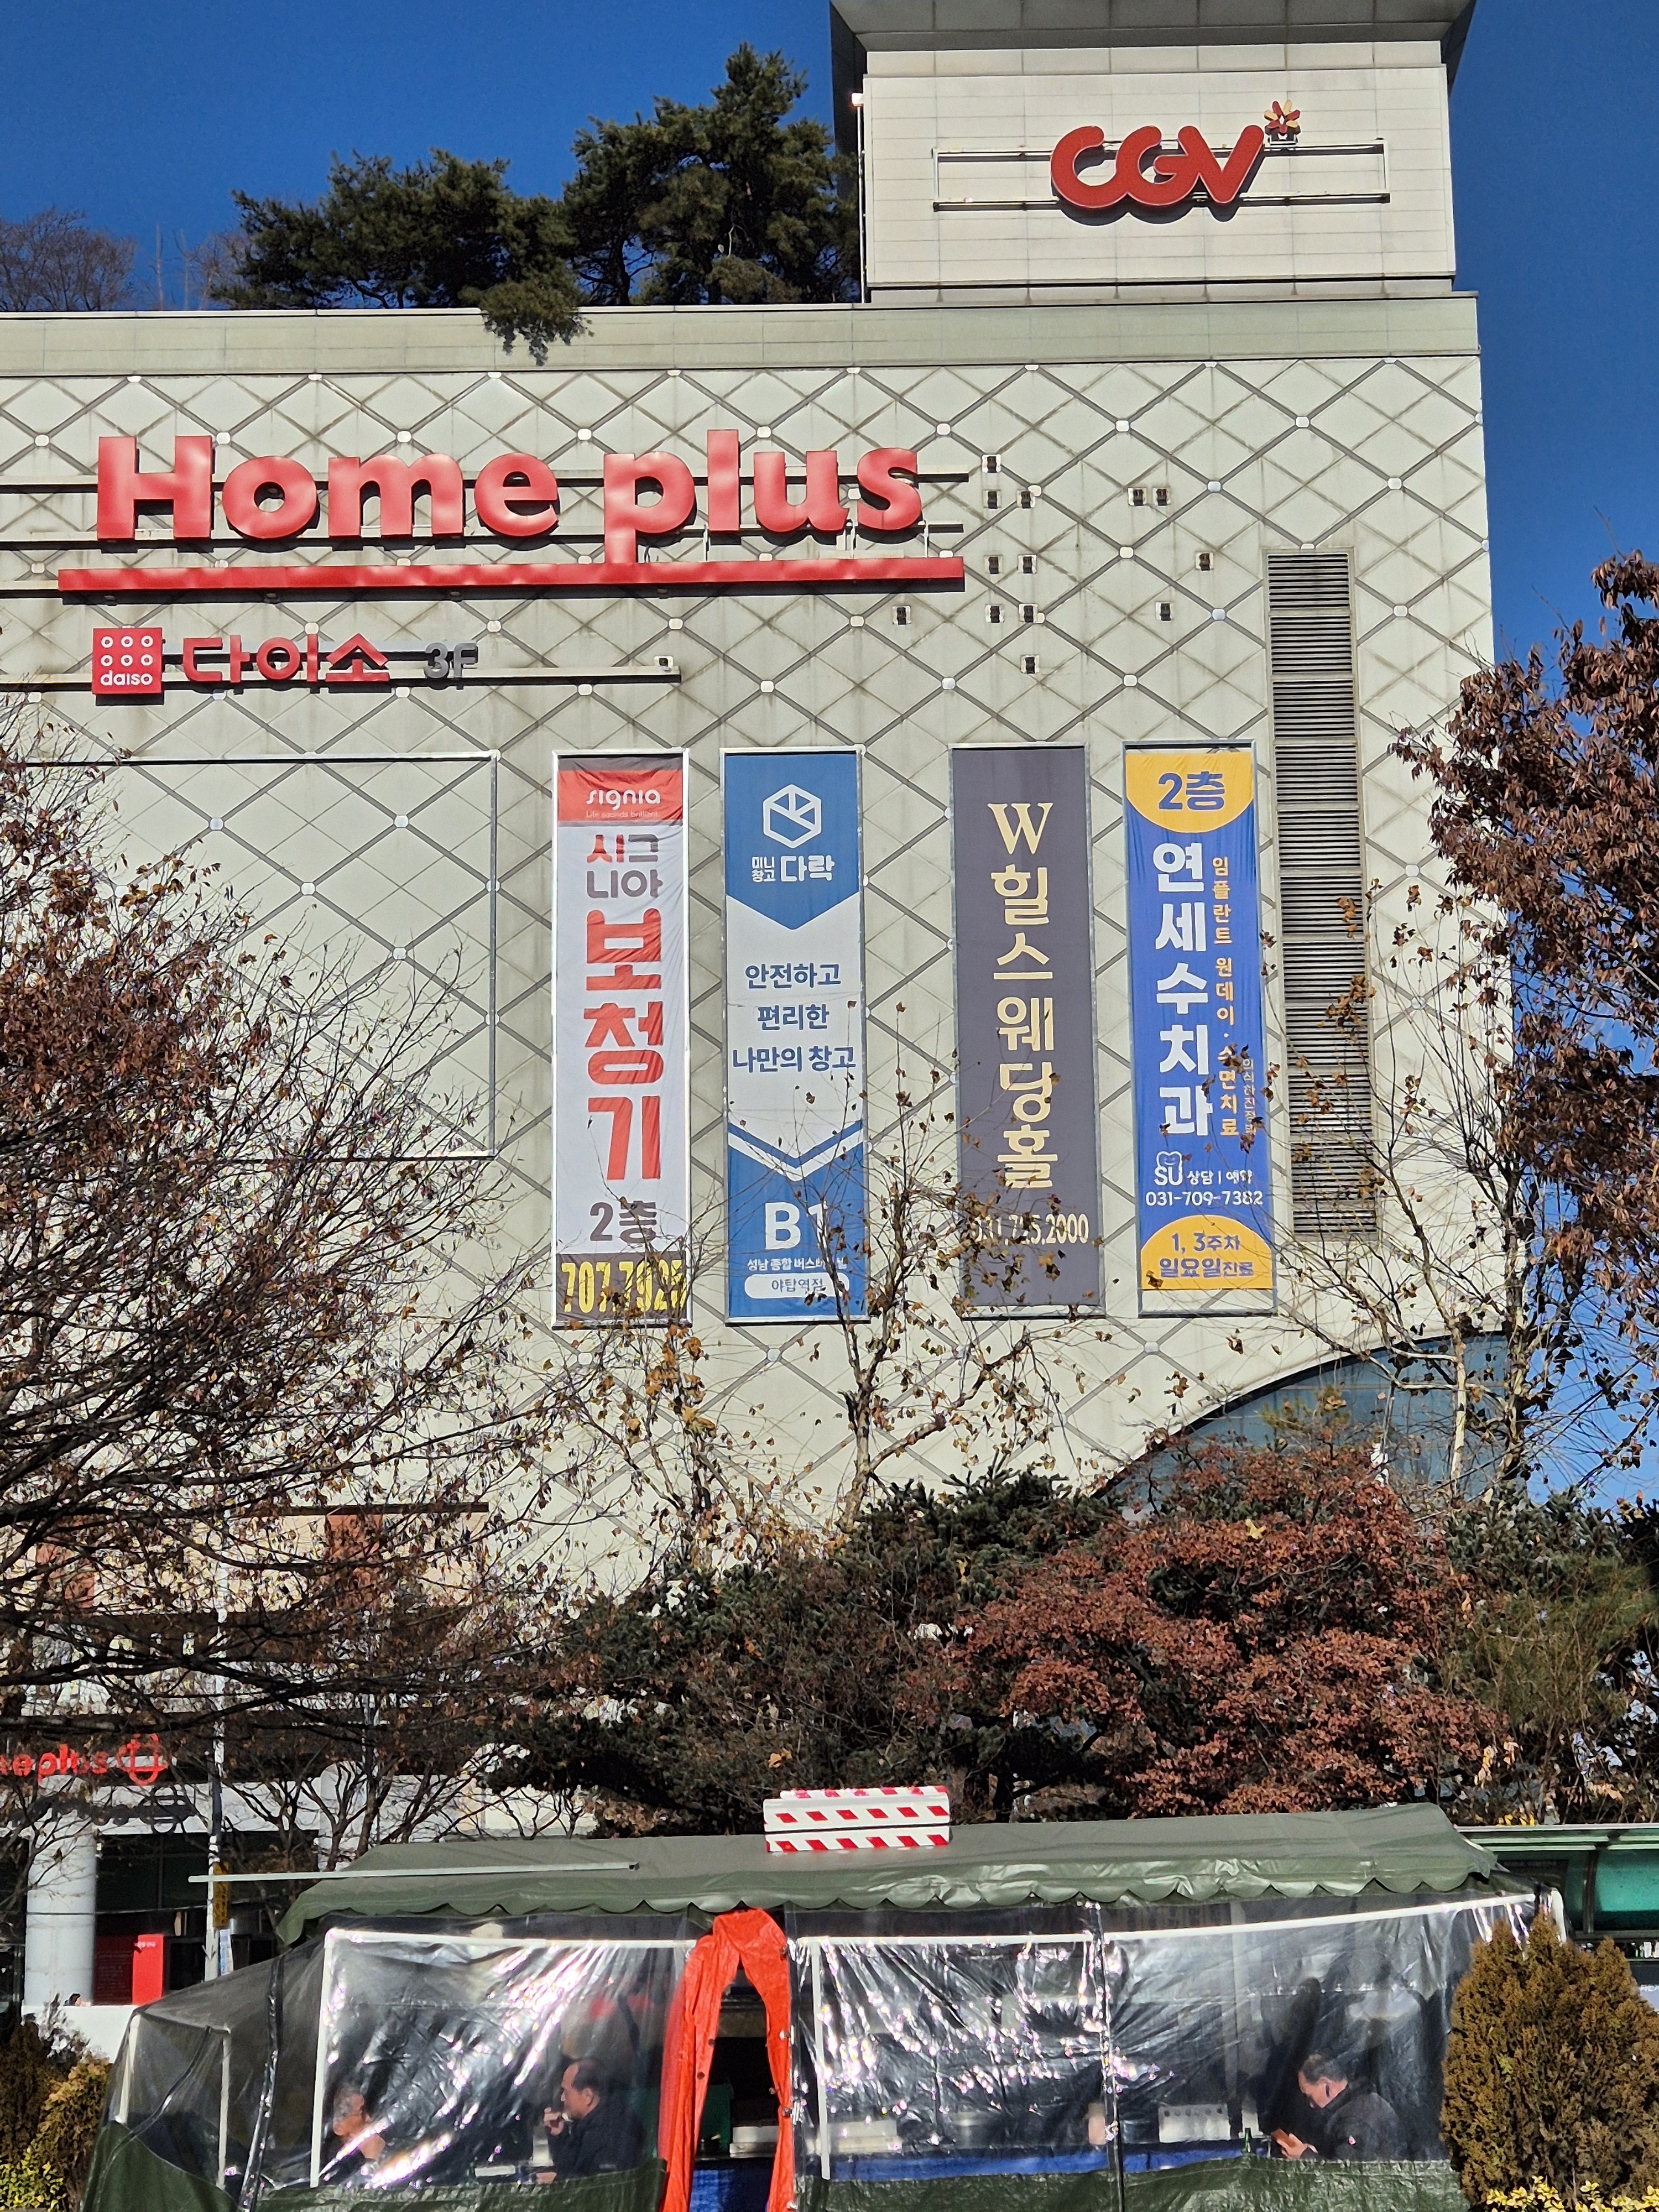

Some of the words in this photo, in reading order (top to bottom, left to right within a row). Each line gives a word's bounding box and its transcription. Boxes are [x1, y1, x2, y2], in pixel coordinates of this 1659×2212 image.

[1051, 125, 1264, 208] CGV
[97, 435, 559, 541] Home
[604, 429, 924, 564] plus
[182, 633, 390, 684] 다이소
[423, 642, 478, 679] 3F
[100, 671, 153, 687] daiso
[586, 789, 660, 811] signia
[1158, 771, 1225, 811] 2층
[587, 834, 659, 863] 시그
[752, 856, 775, 869] 미니
[780, 854, 835, 882] 다락
[587, 869, 663, 899] 니아
[1212, 856, 1233, 945] 임플란트
[744, 963, 842, 989] 안전하고
[1152, 842, 1213, 1136] 연세수치과
[757, 1004, 830, 1031] 편리한
[583, 907, 664, 1181] 보청기
[732, 1047, 802, 1073] 나만의
[808, 1046, 857, 1072] 창고
[1154, 1166, 1183, 1186] SU
[1187, 1170, 1214, 1185] 상담
[1145, 1190, 1264, 1206] 031-709-7382
[589, 1200, 658, 1244] 2층
[765, 1200, 830, 1250] B1
[1193, 1232, 1240, 1251] 3주차
[1159, 1258, 1254, 1278] 일요일진료
